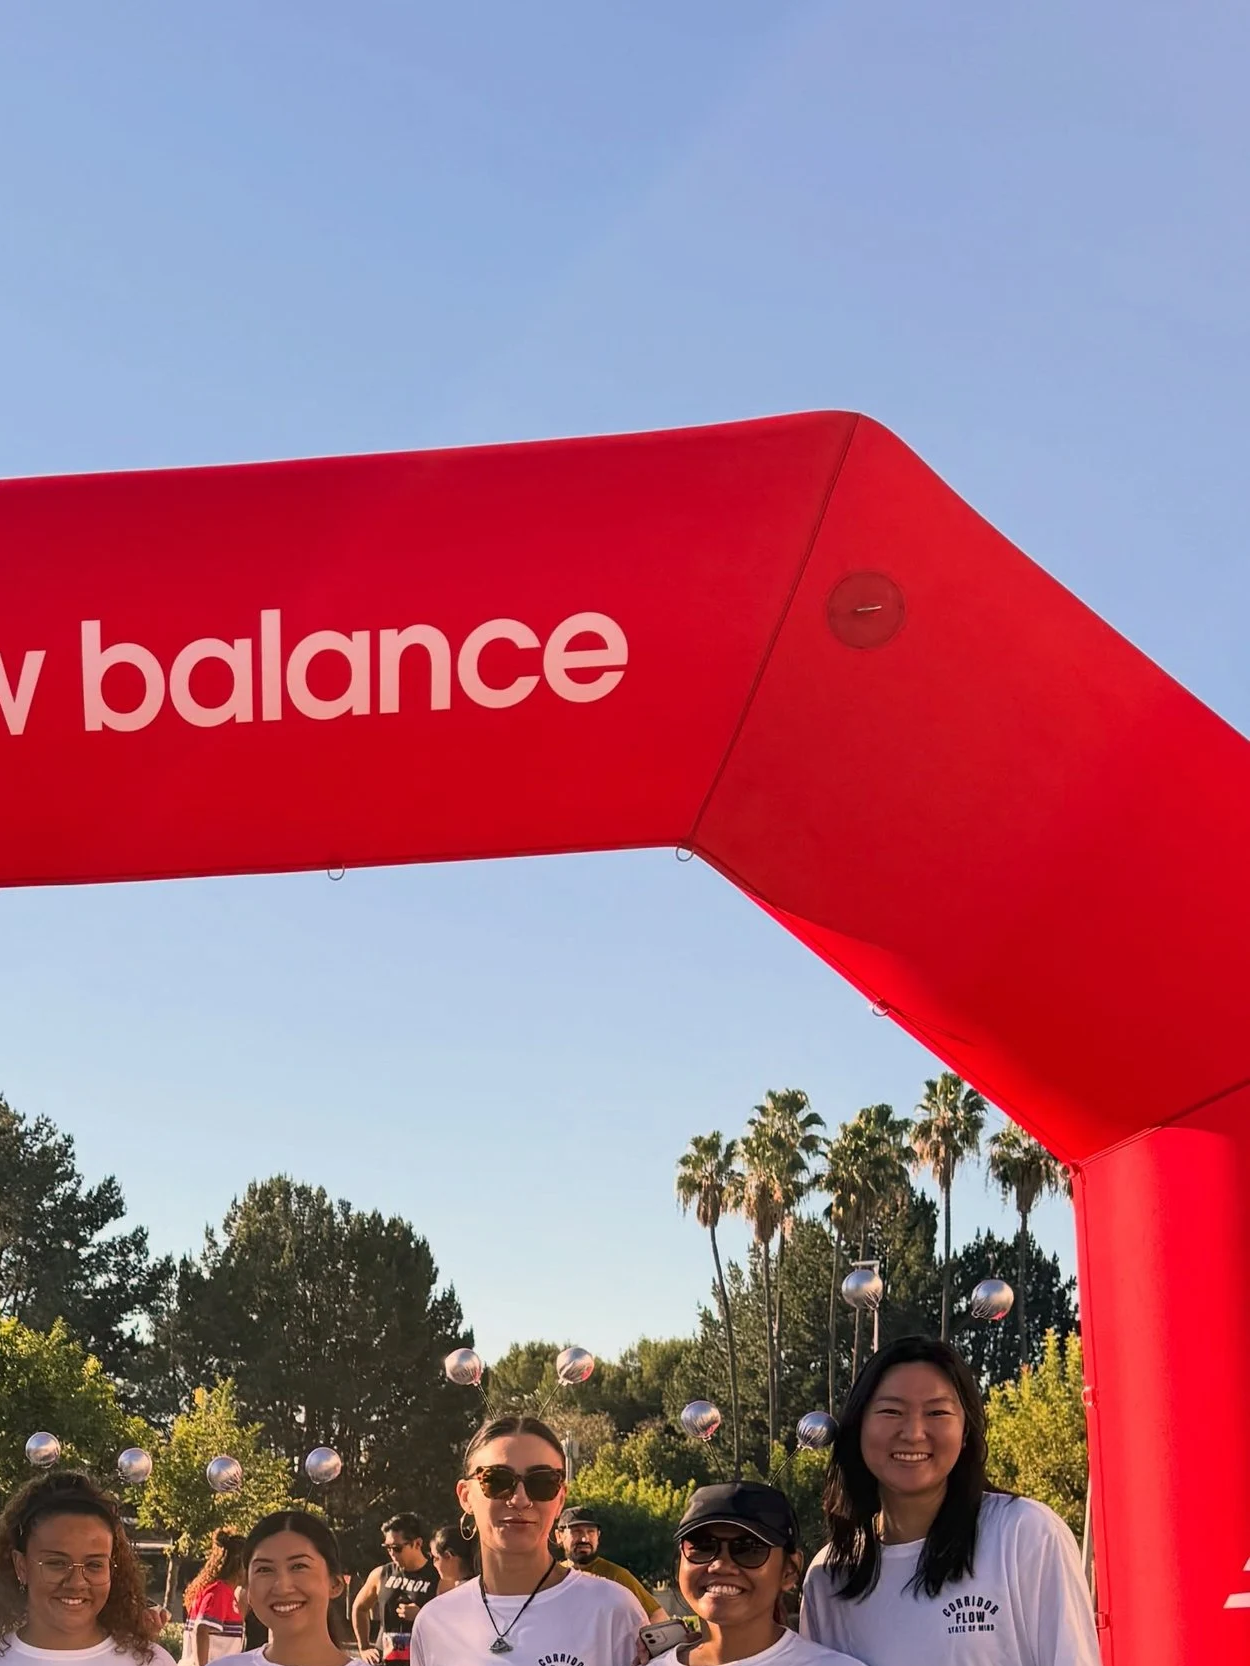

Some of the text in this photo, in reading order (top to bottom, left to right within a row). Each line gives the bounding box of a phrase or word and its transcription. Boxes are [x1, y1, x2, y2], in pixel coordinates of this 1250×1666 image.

[80, 608, 629, 733] balance
[942, 1595, 998, 1617] CORRIDOR
[956, 1611, 985, 1624] FLOW
